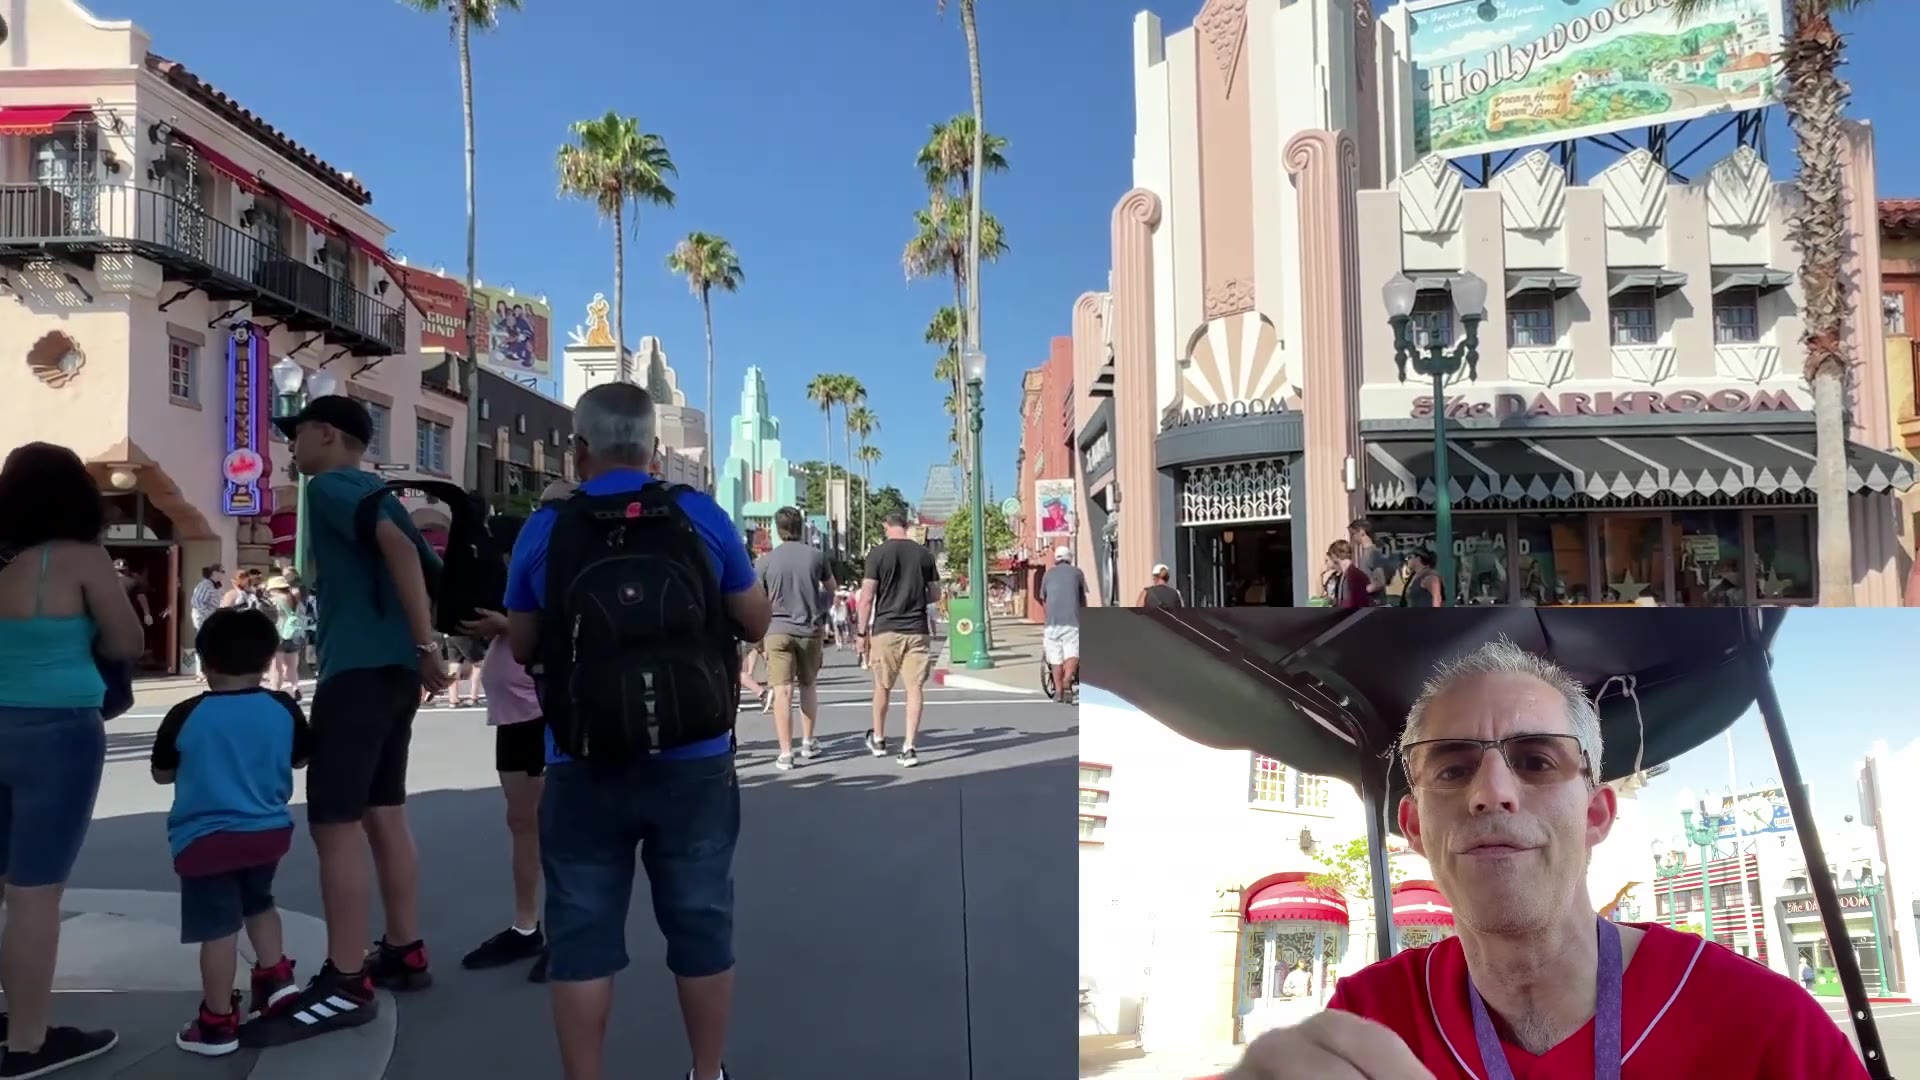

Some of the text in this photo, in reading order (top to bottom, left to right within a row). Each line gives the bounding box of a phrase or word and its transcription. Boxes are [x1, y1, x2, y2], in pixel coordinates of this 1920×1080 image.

[1495, 94, 1532, 107] Dream
[1492, 108, 1527, 121] Dream
[1410, 389, 1801, 419] The DARKROOM
[1787, 895, 1869, 913] The DAOOM
